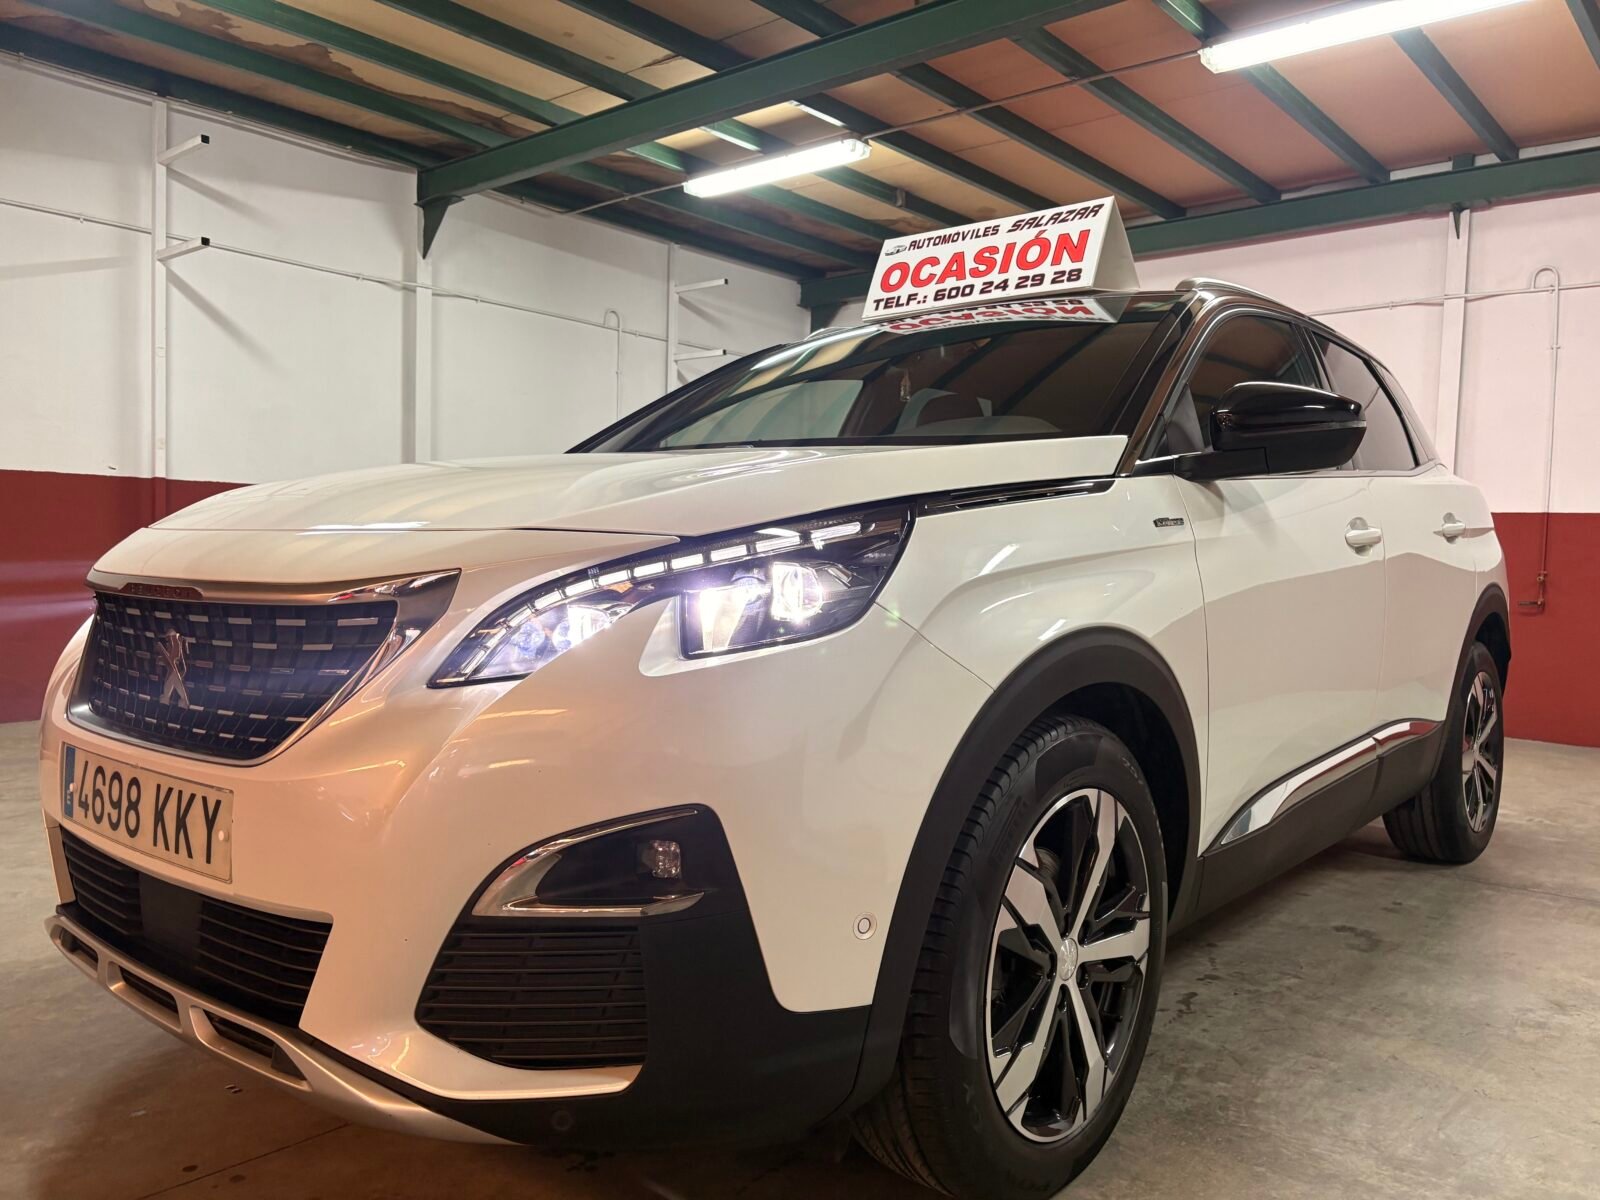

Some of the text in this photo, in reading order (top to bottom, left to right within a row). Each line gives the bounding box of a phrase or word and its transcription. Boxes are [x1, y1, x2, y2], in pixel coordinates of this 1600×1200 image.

[1006, 203, 1105, 233] SALAZAR
[880, 229, 1091, 293] OCASIÓN
[873, 268, 1082, 311] TELF.: 600 24 29 28
[78, 760, 222, 865] 4698 KKY
